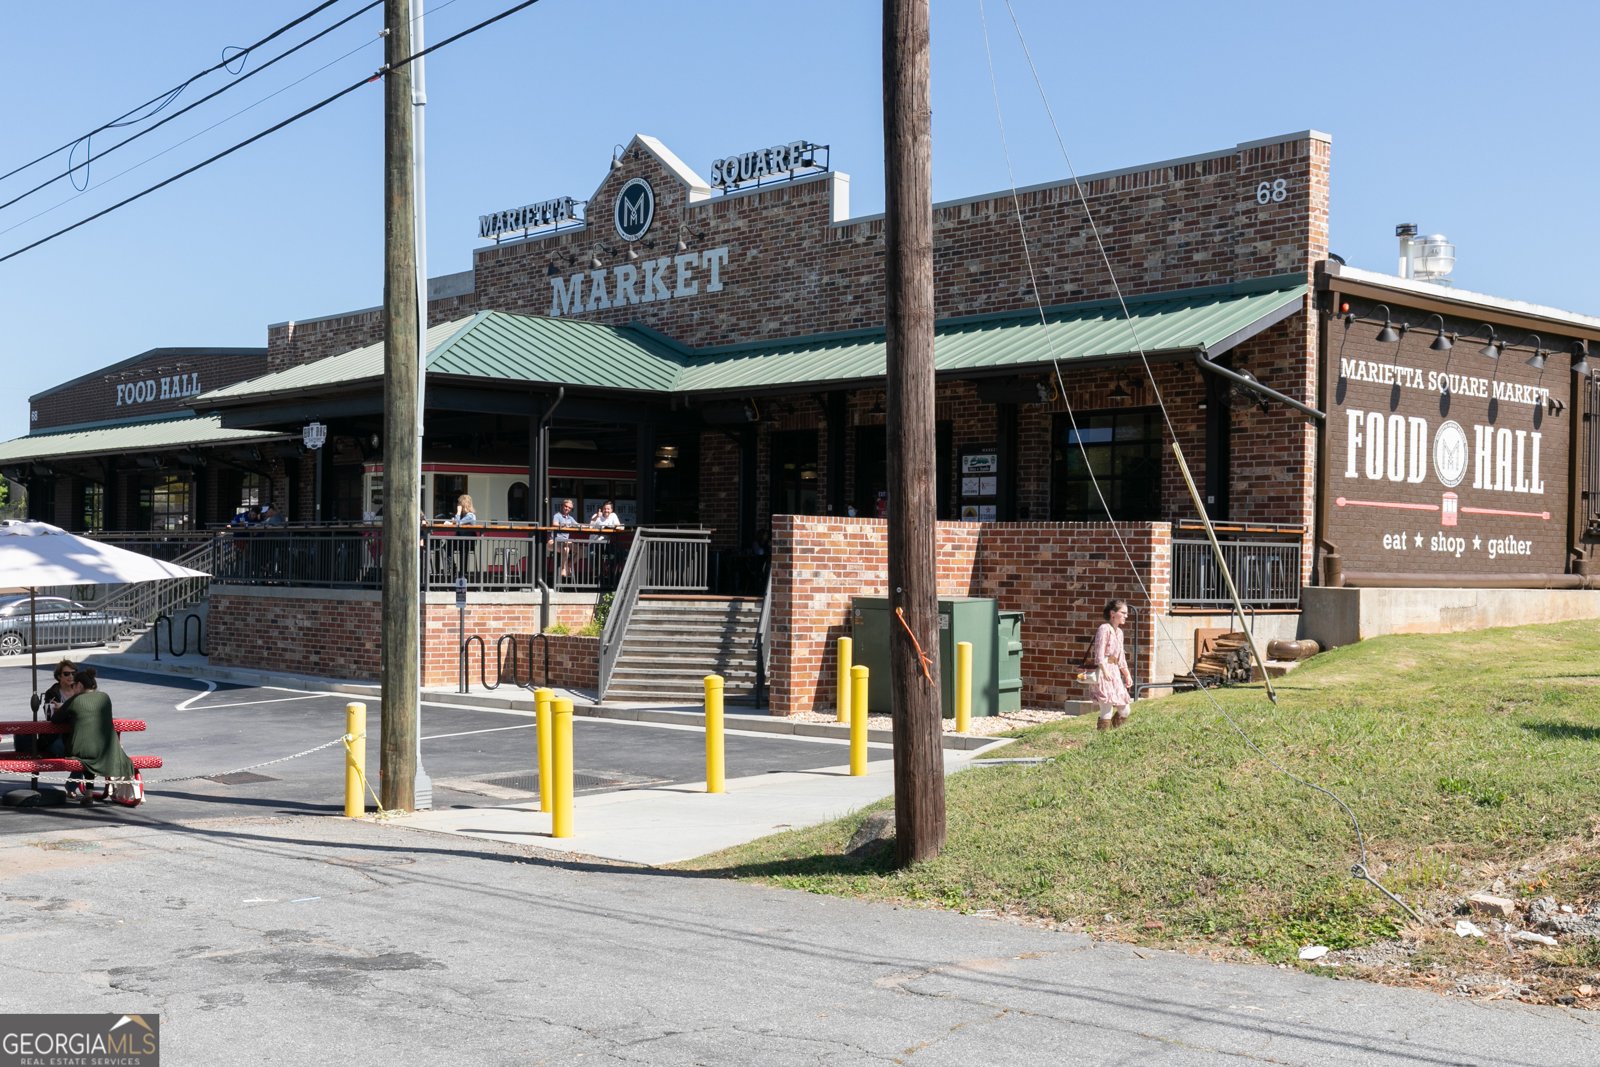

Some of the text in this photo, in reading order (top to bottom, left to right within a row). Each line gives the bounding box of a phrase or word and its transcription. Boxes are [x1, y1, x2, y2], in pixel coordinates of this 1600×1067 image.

[478, 140, 807, 238] MARIETTA SQUARE
[1256, 178, 1287, 205] 68
[551, 247, 729, 317] MARKET
[116, 373, 201, 407] FOOD HALL
[1340, 357, 1550, 407] MARIETTA SQUARE MARKET
[31, 410, 38, 422] 68
[1344, 408, 1545, 495] FOOD HALL
[1382, 531, 1533, 559] eat shop gather
